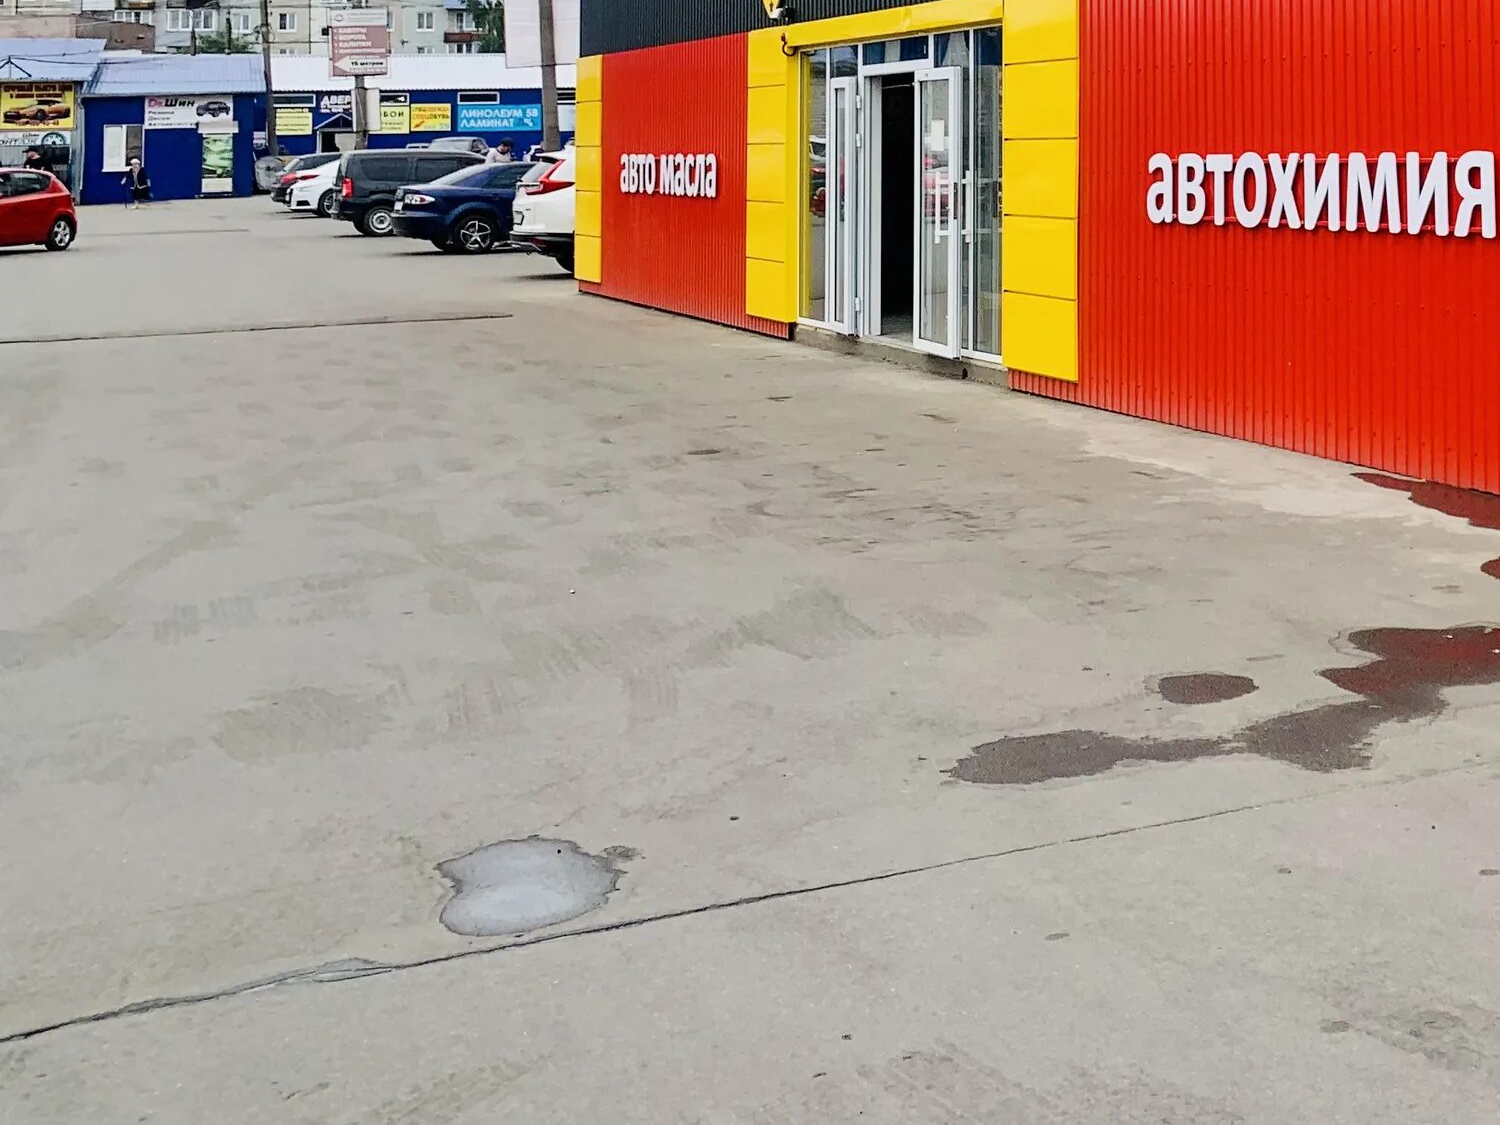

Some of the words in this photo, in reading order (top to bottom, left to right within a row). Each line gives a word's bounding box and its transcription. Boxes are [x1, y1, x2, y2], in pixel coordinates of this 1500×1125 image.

[381, 110, 405, 118] БОИ
[461, 108, 523, 118] ЛИНОЛЕУМ
[461, 118, 515, 128] ЛАМИНАТ
[620, 153, 656, 195] авто
[659, 153, 717, 198] масла
[1146, 150, 1497, 239] автохимия
